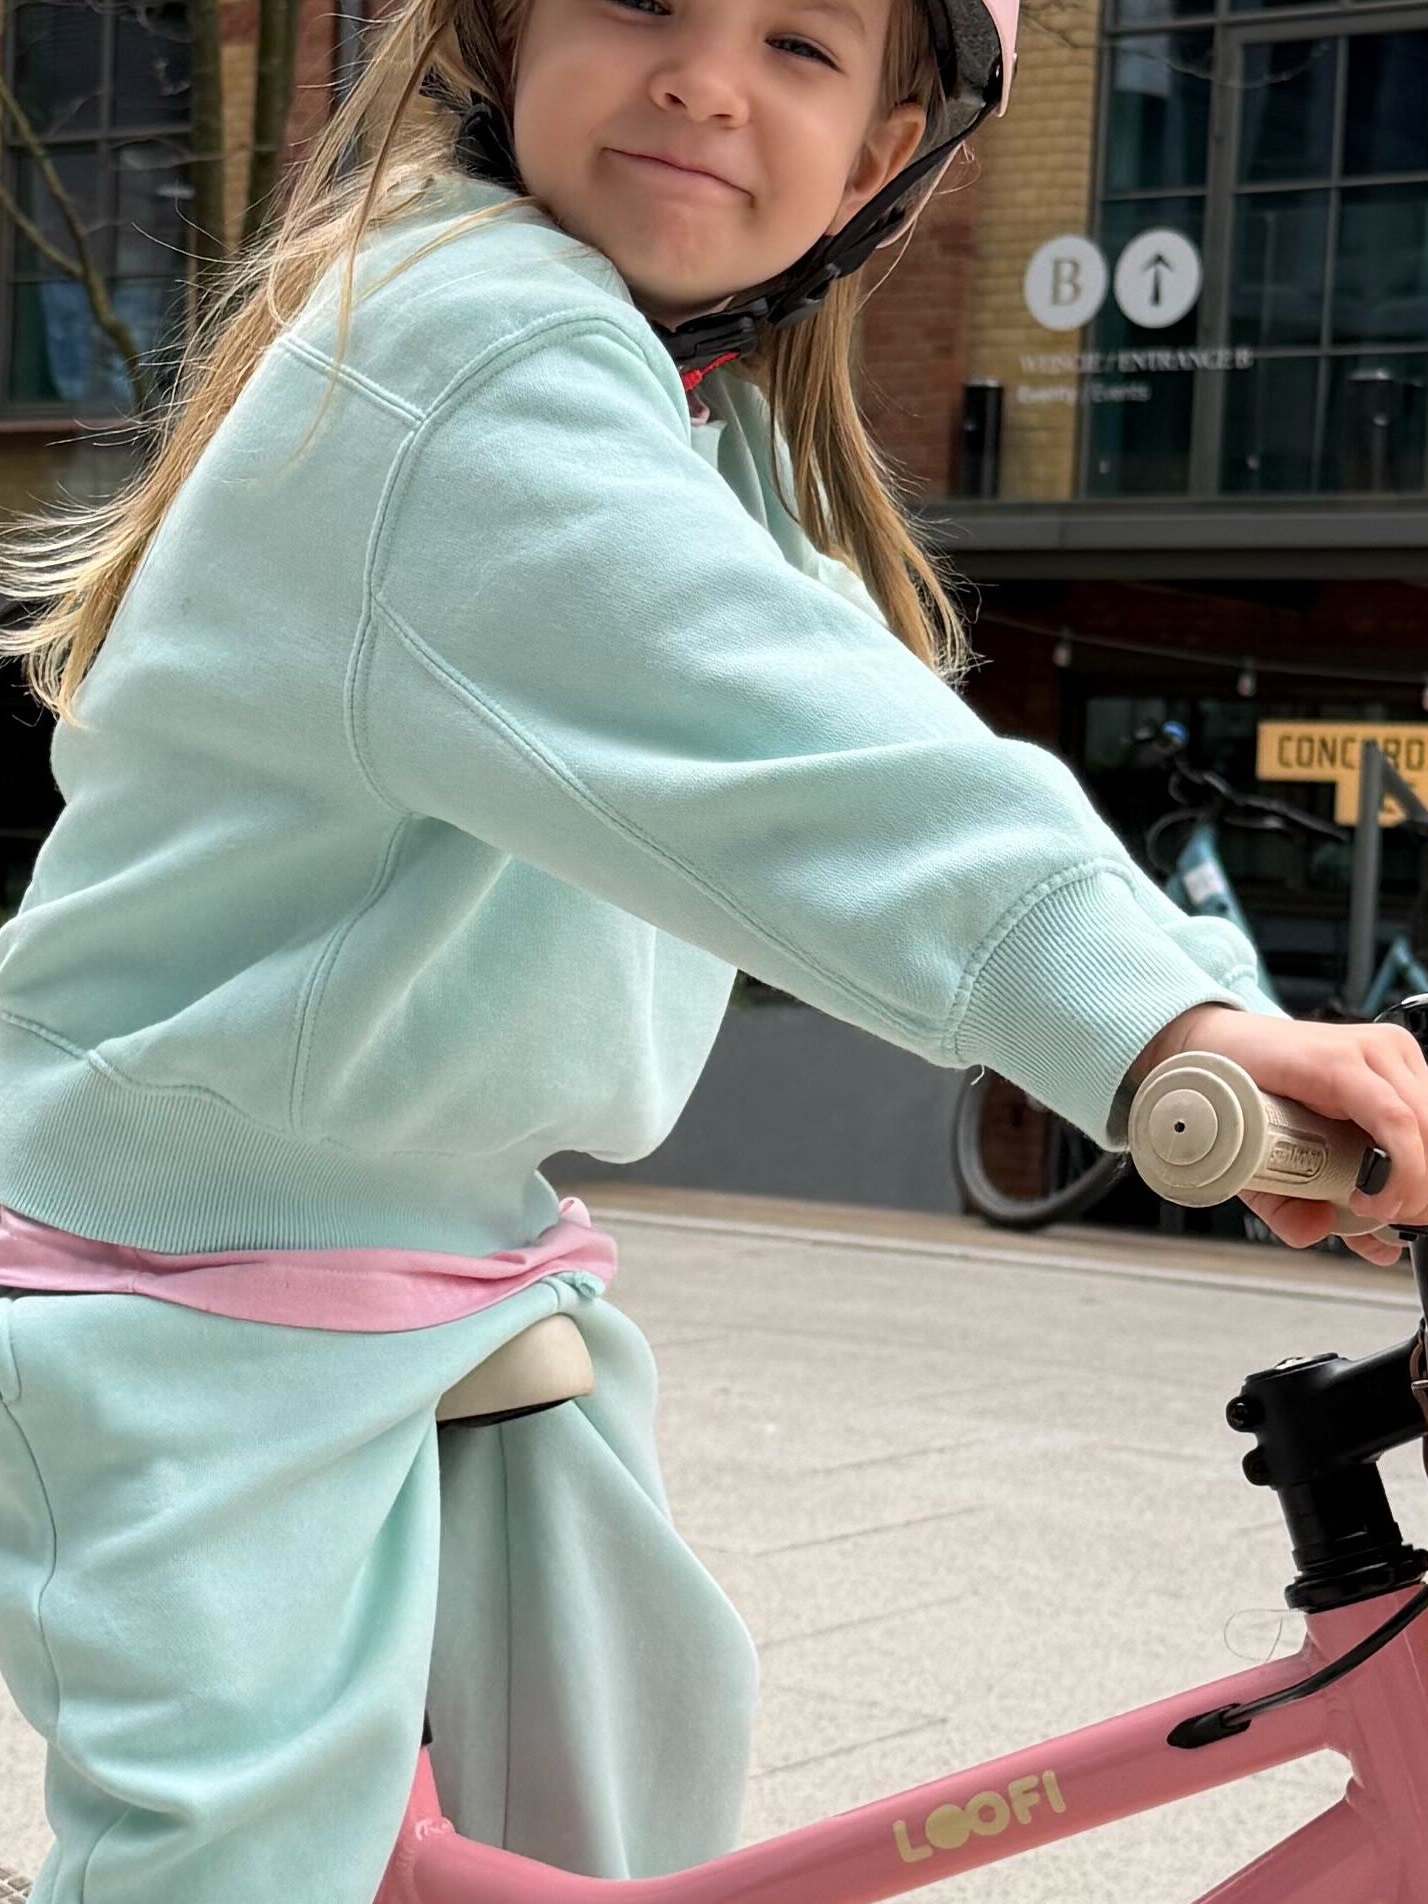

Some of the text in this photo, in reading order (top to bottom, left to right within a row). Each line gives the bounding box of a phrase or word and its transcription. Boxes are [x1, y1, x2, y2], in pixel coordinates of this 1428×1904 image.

[1051, 258, 1084, 304] B
[1117, 348, 1233, 373] ENTRANCE
[892, 1769, 1067, 1865] LOOFI
